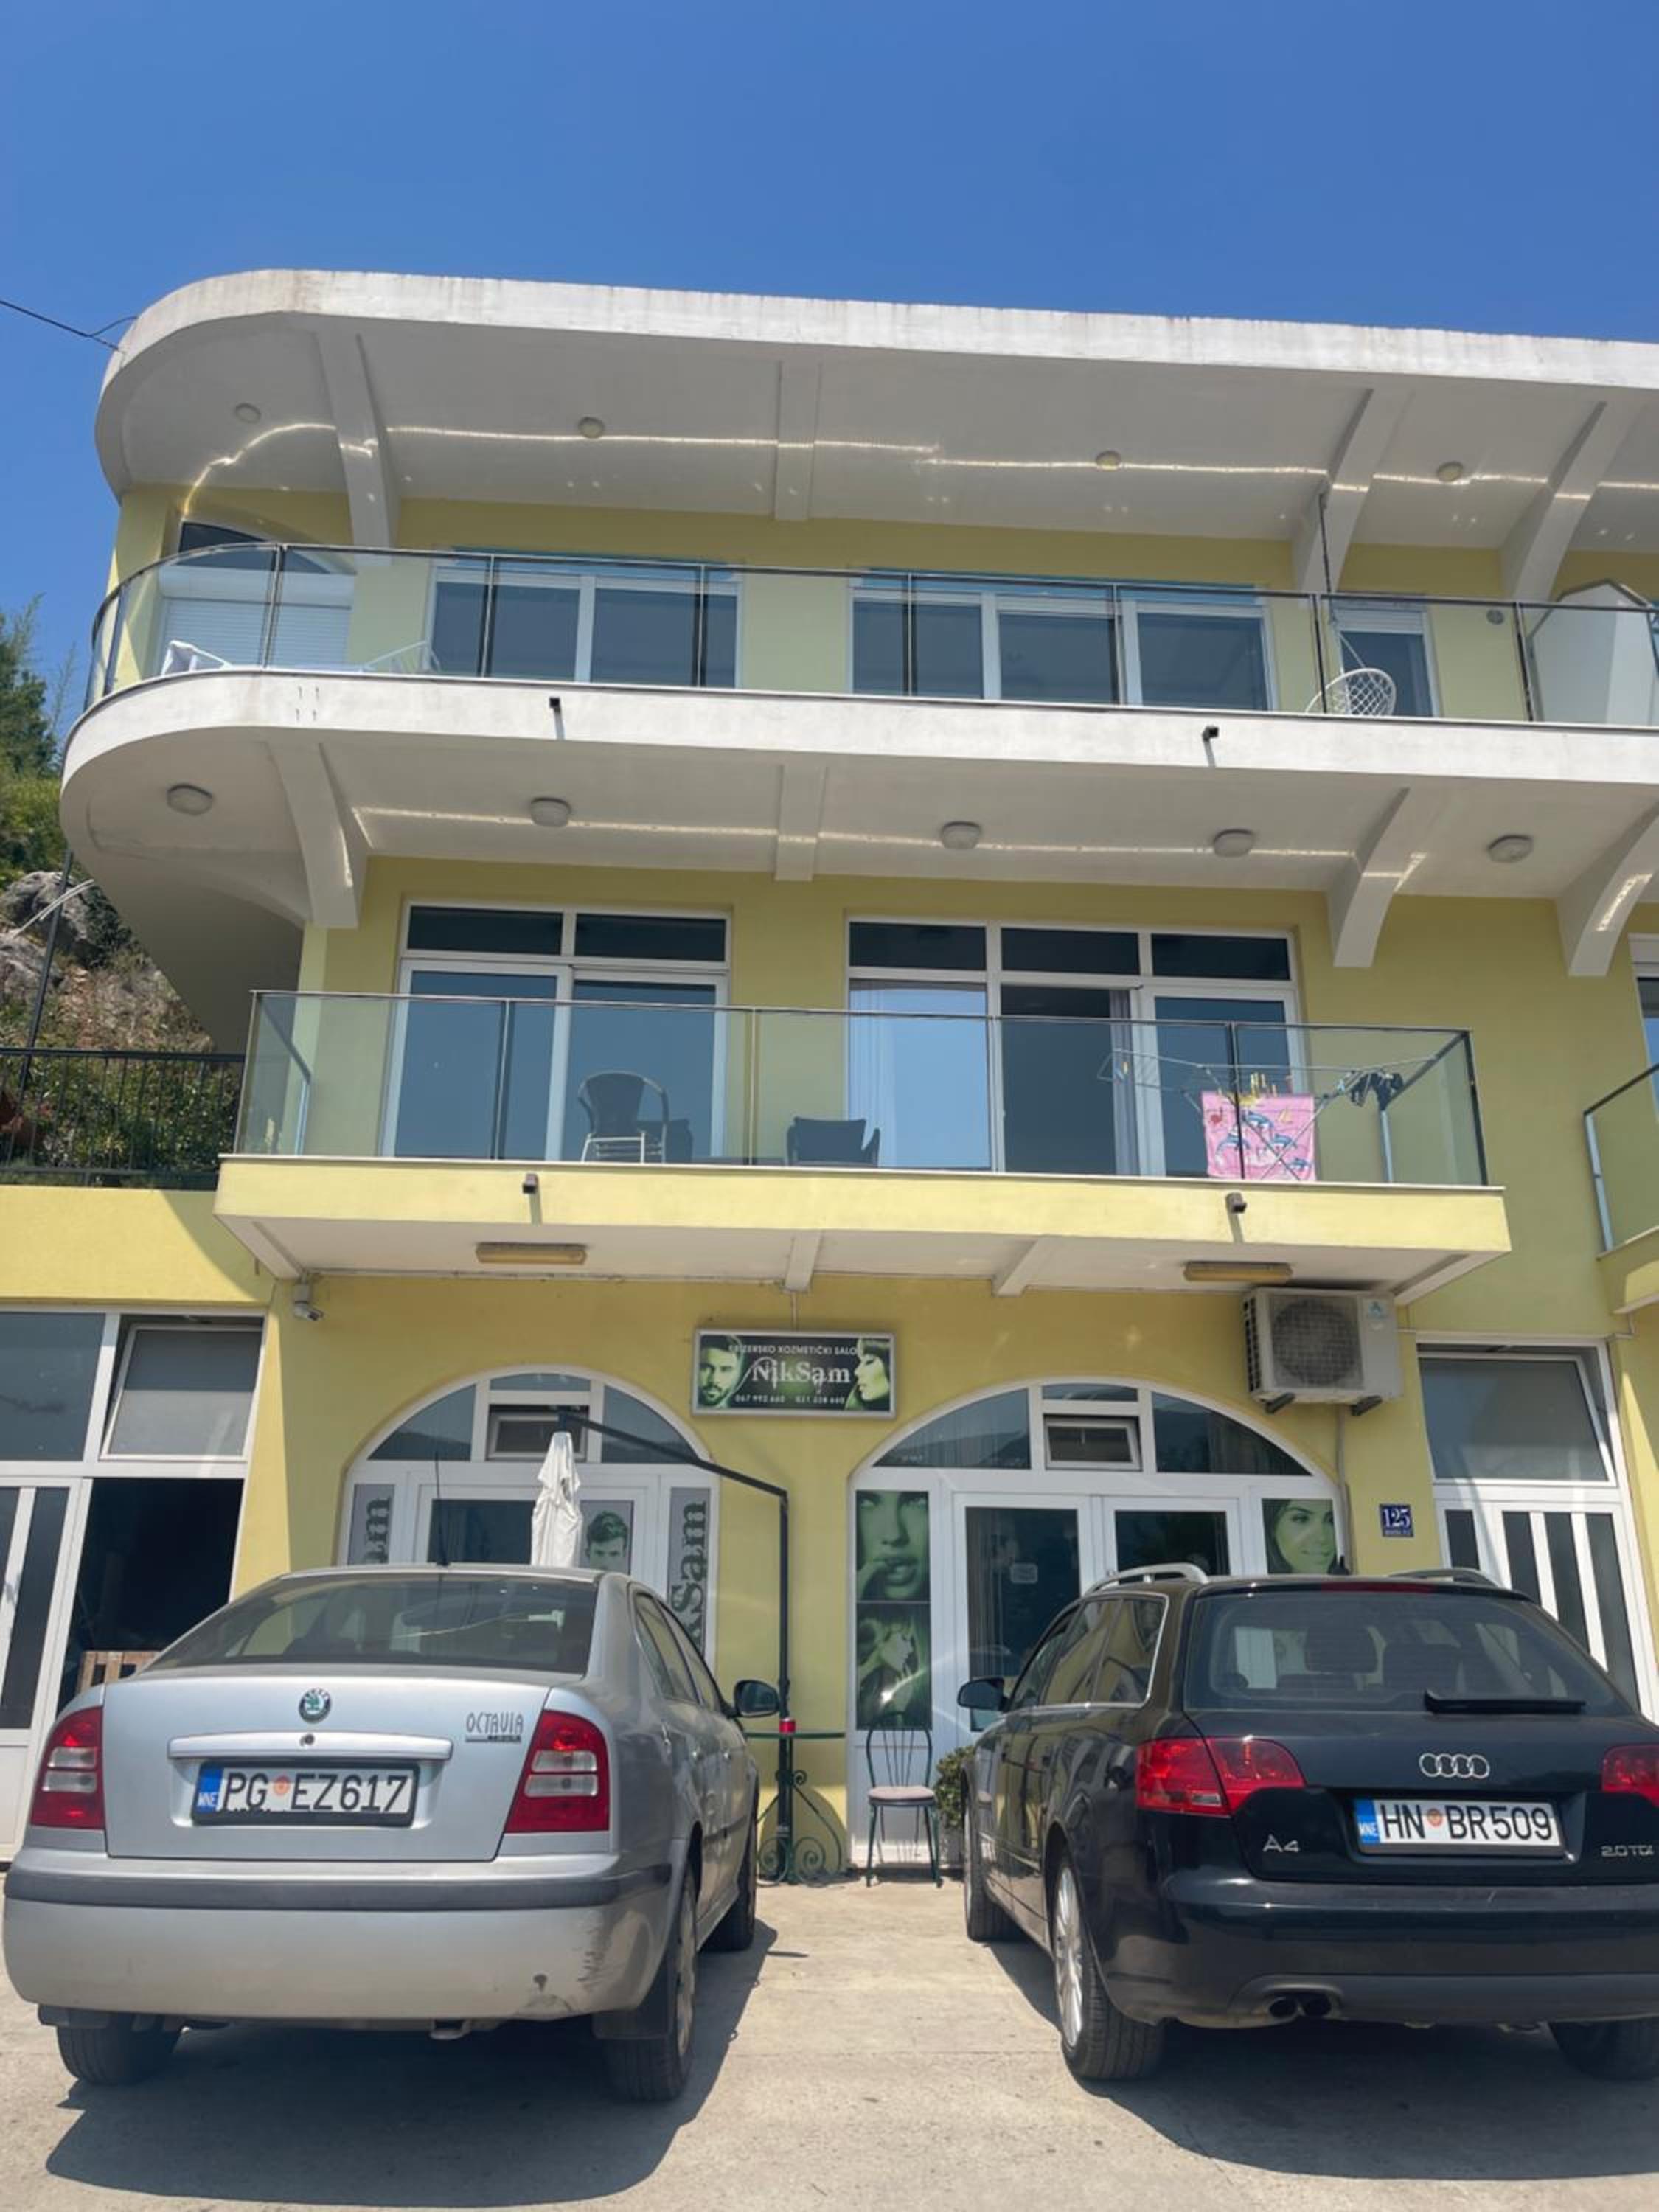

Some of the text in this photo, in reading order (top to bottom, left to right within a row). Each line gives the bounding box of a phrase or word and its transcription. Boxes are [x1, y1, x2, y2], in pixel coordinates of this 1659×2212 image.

[751, 1357, 851, 1391] NikSam
[1383, 1508, 1411, 1528] 125
[466, 1711, 524, 1735] OCTAVIA
[223, 1772, 269, 1808] PG
[291, 1773, 408, 1812] EZ617
[1380, 1804, 1426, 1839] HN
[1445, 1804, 1553, 1840] BR509
[1262, 1834, 1301, 1853] A4
